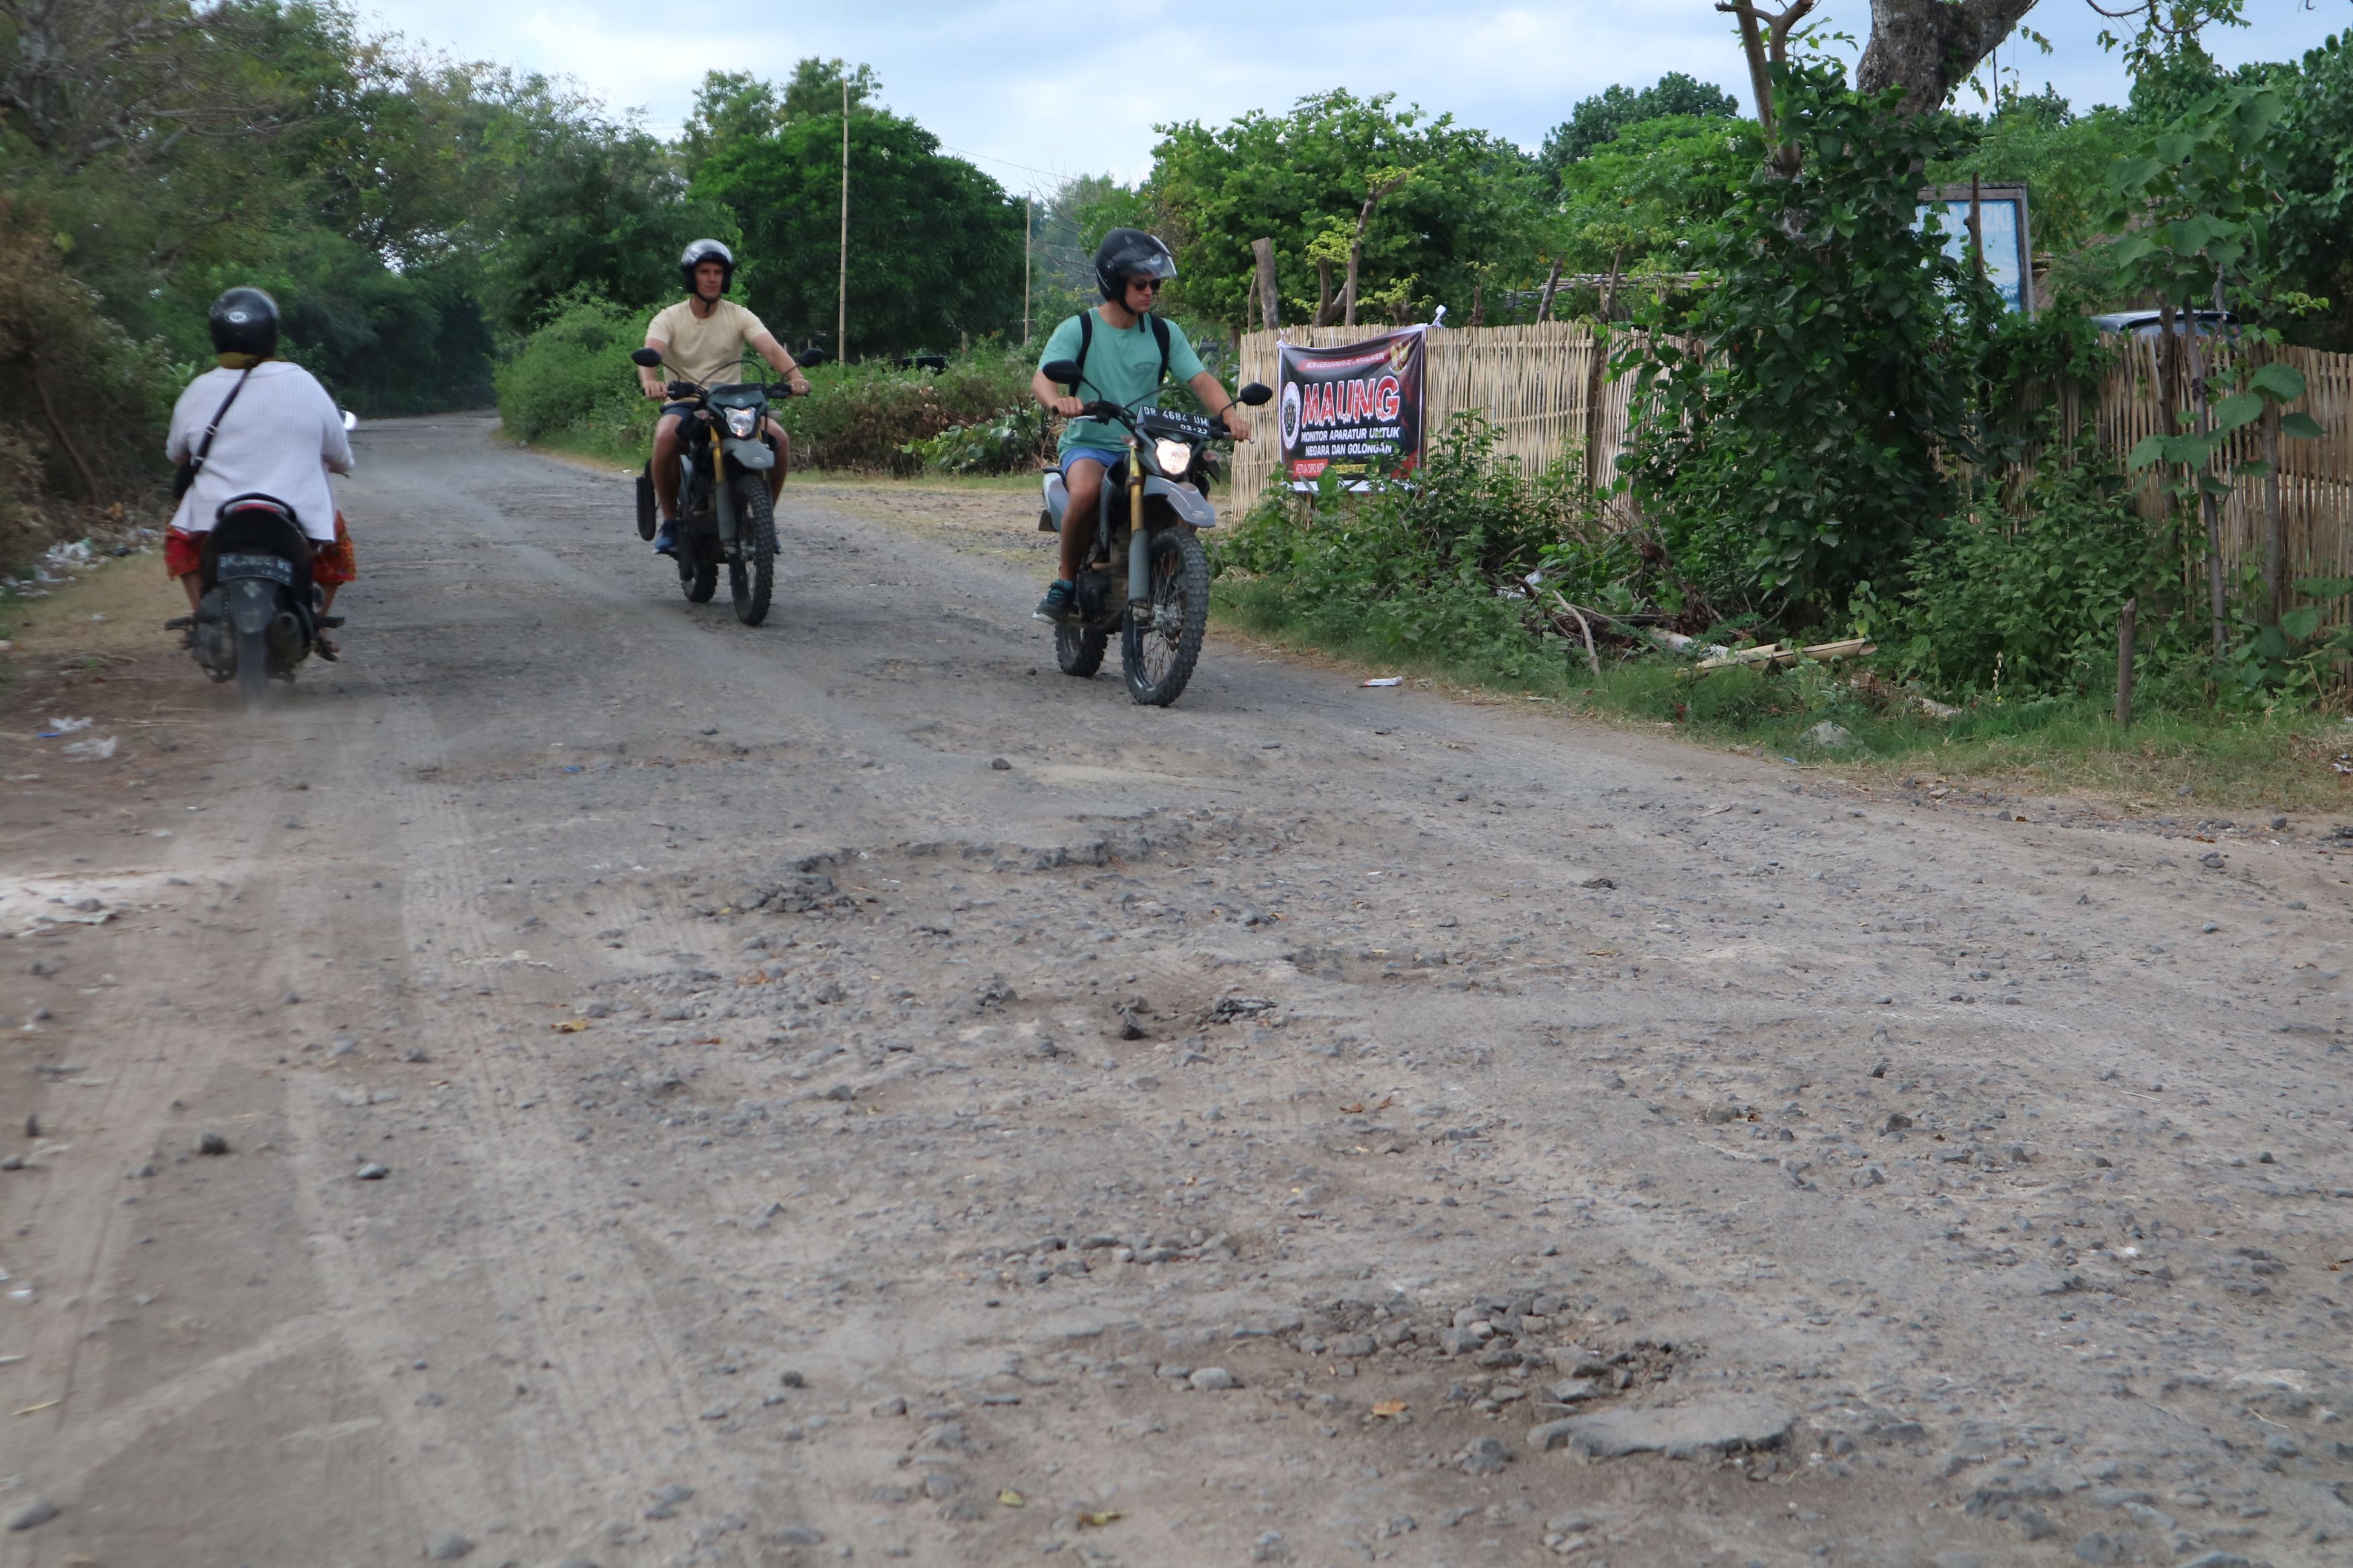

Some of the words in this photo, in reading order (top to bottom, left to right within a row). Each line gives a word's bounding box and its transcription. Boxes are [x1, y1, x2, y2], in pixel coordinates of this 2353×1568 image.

[1302, 375, 1400, 429] MAUNG
[1144, 406, 1156, 416] DR
[1162, 410, 1187, 421] 4684
[1193, 415, 1208, 426] UM
[1301, 429, 1328, 442] MONITOR
[1329, 428, 1367, 441] APARATUR
[1369, 426, 1400, 439] UNTUK
[1305, 444, 1330, 456] NEGARA
[1331, 444, 1346, 455] DAN
[1347, 442, 1392, 455] GOLONGAN
